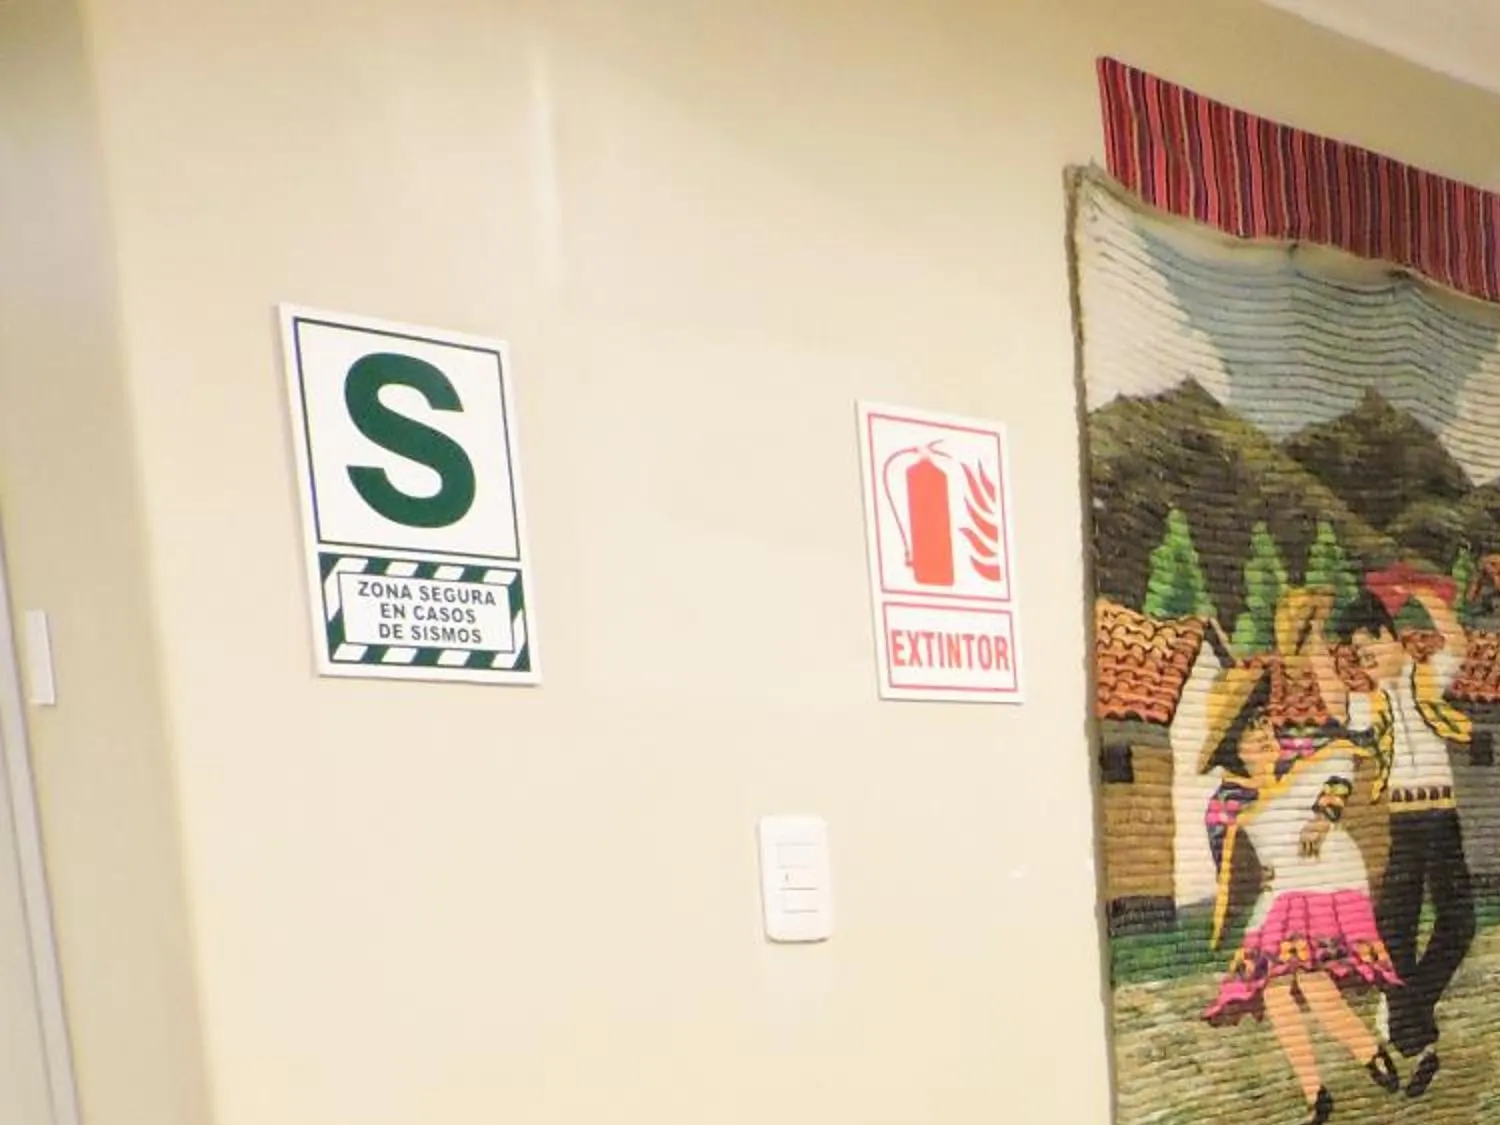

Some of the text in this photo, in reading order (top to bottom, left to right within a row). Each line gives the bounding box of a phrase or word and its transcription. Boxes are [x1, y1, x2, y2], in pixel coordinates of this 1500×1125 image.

[344, 351, 477, 529] S
[358, 581, 497, 606] ZONA SEGURA
[380, 603, 477, 624] EN CASOS
[379, 623, 482, 644] DE SISMOS
[890, 629, 1011, 672] EXTINTOR
